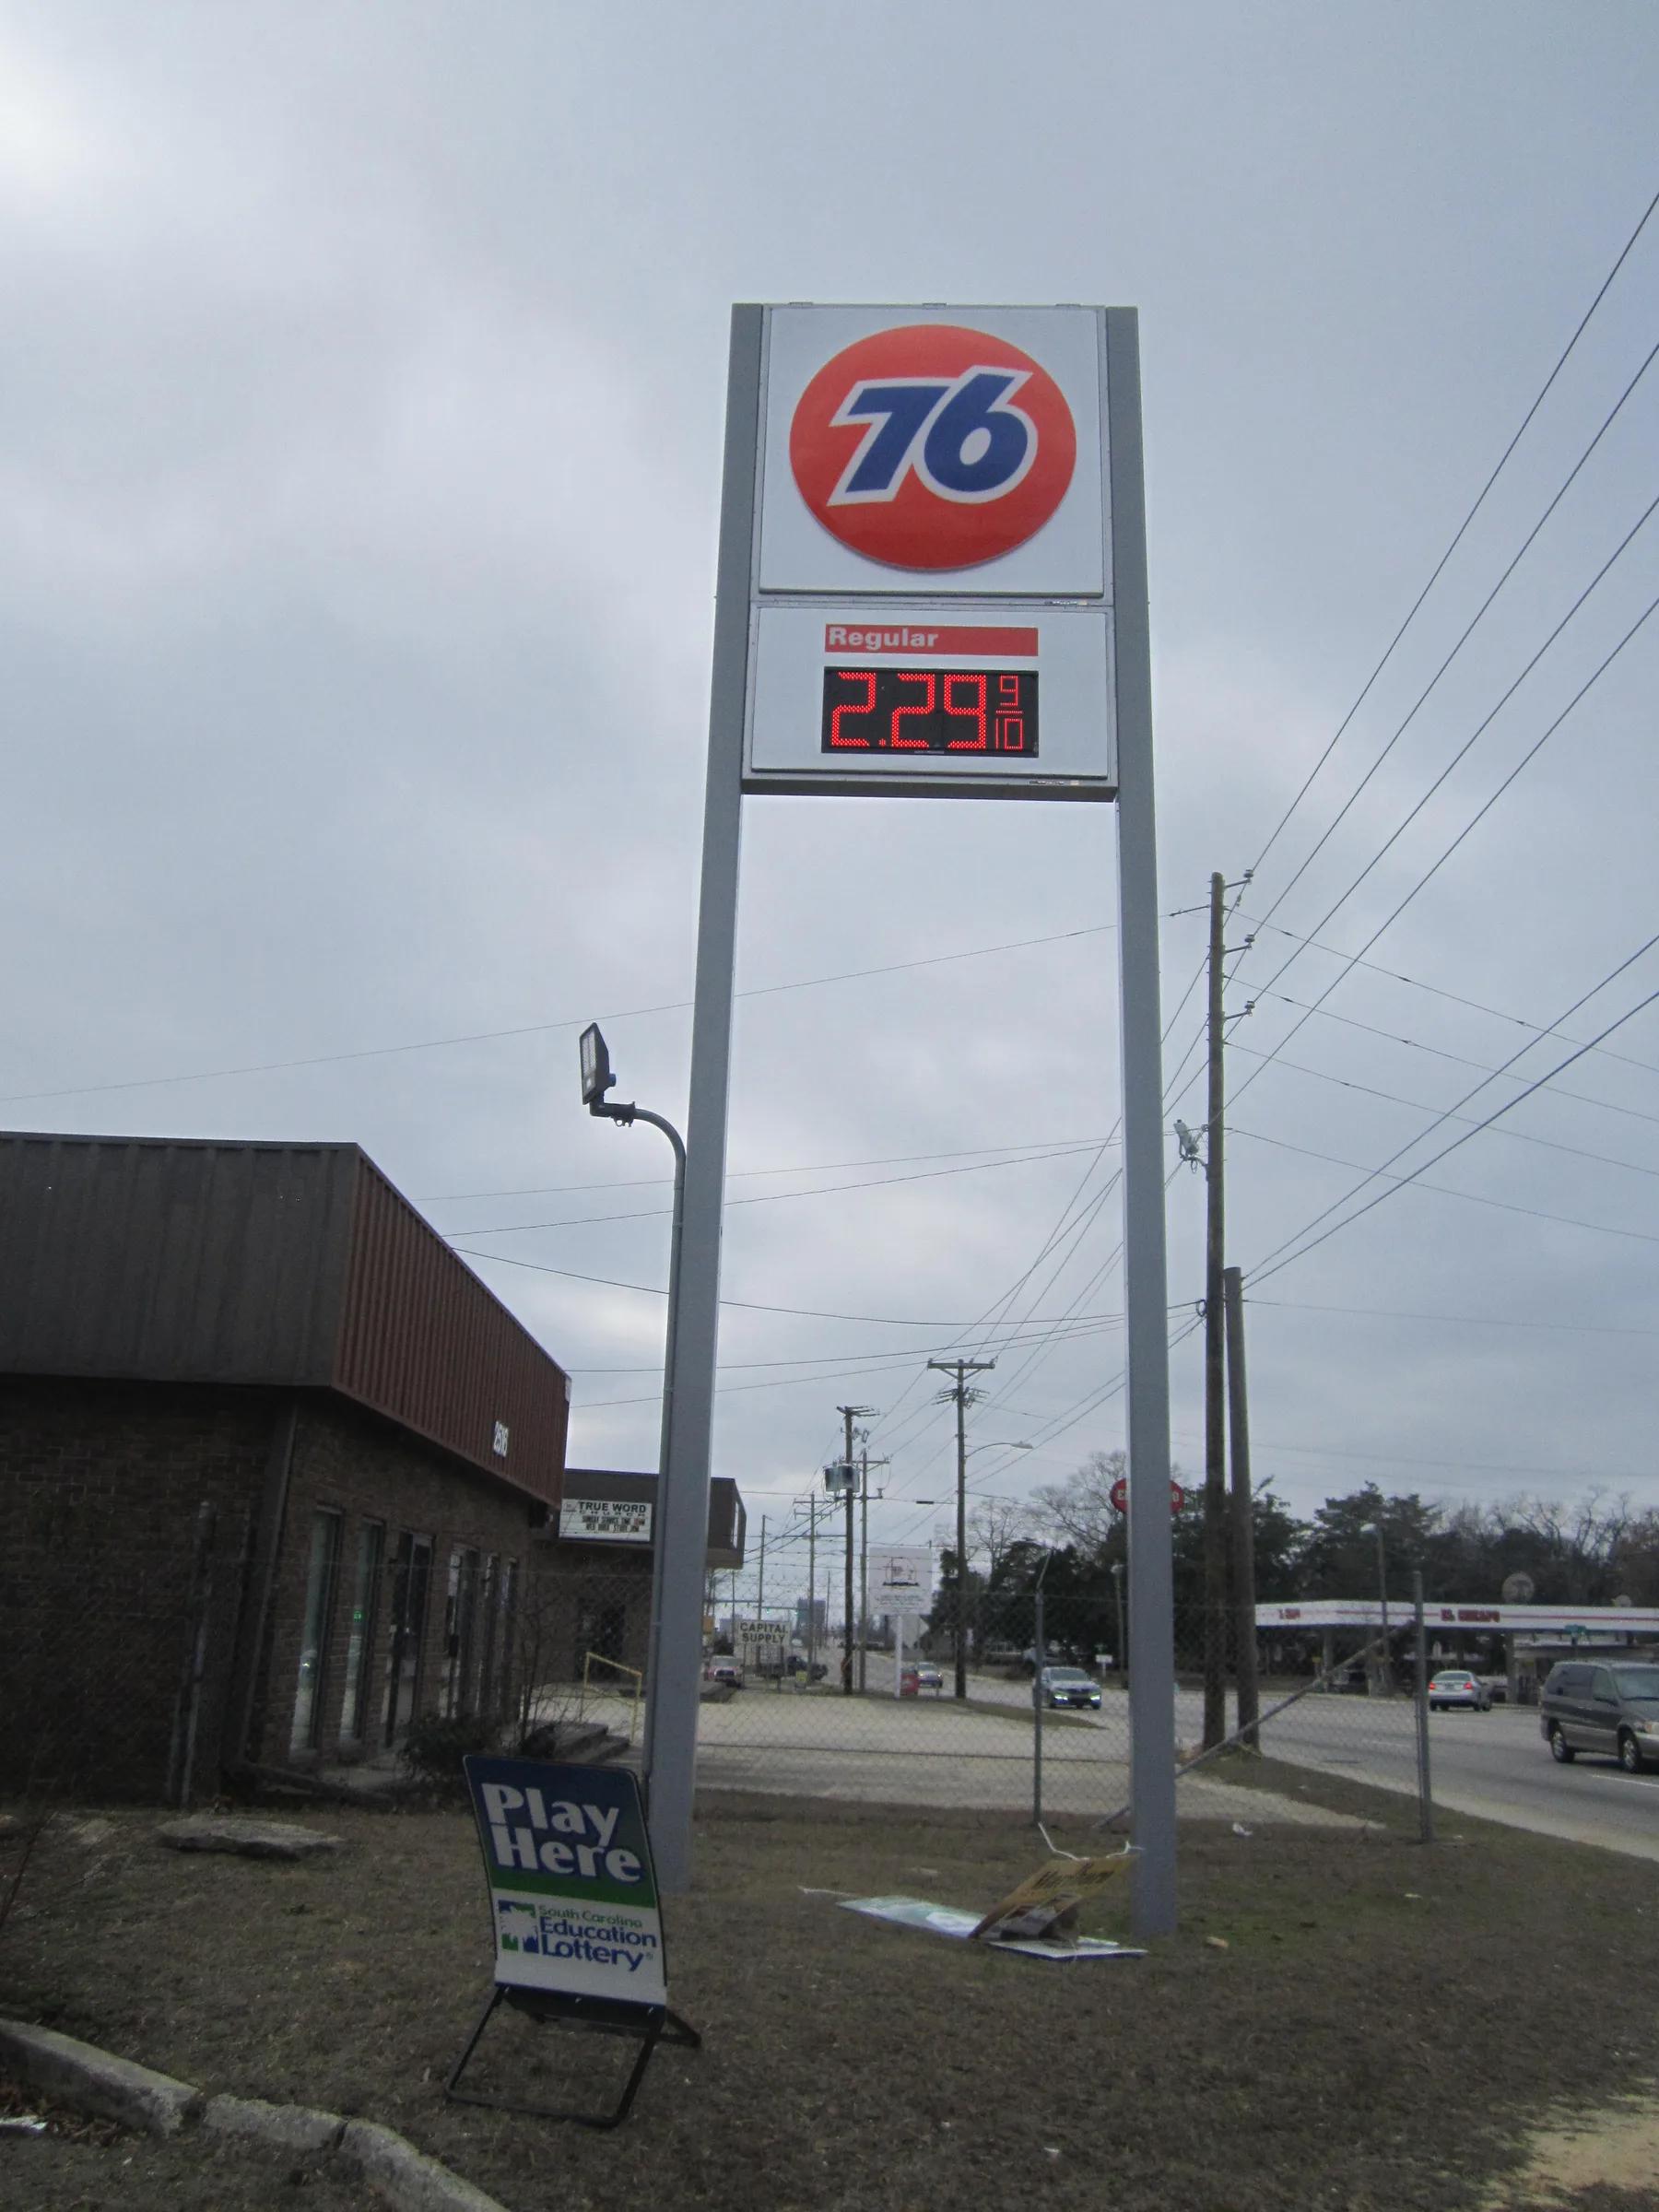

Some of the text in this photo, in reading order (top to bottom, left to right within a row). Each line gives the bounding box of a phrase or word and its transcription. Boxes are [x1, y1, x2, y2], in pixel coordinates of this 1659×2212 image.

[826, 364, 1039, 506] 76
[829, 627, 939, 651] Regular
[831, 672, 987, 749] 2.29
[579, 1501, 608, 1512] TRUE
[613, 1503, 646, 1513] WORD
[740, 1622, 789, 1634] CAPITAL
[742, 1632, 785, 1643] SUPPLY
[481, 1783, 619, 1847] Play
[490, 1824, 641, 1882] Here
[539, 1905, 642, 1928] South Carolina
[540, 1916, 657, 1947] Education
[541, 1934, 644, 1971] Lottery
